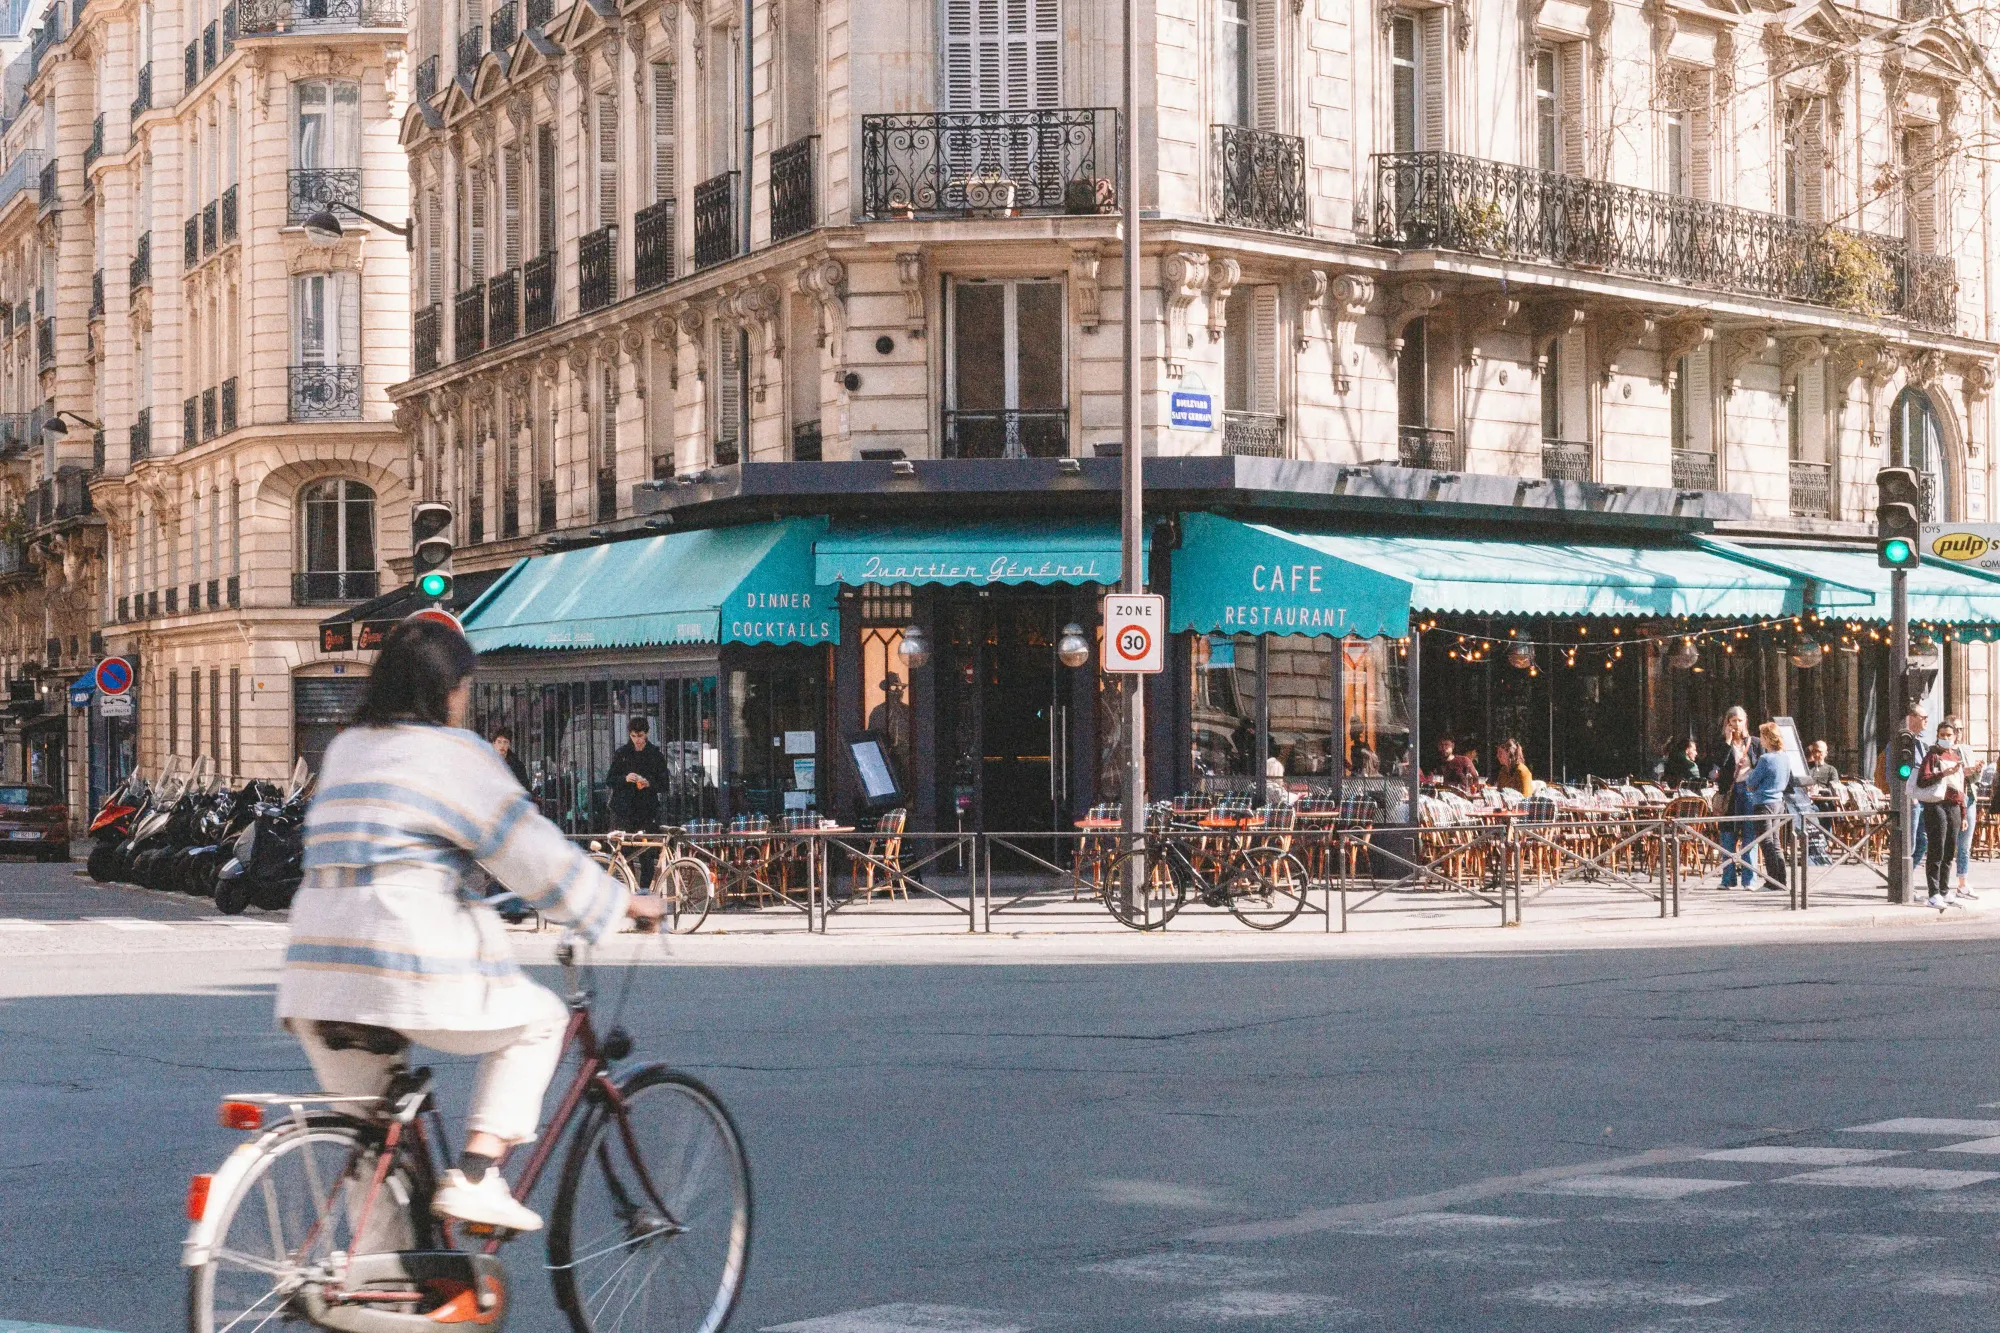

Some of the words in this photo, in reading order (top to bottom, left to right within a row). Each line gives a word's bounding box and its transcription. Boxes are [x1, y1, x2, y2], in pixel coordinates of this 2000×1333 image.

[1176, 399, 1208, 409] BOULEVARD
[1921, 525, 1941, 534] TOYS
[861, 556, 983, 578] Quartier
[986, 556, 1100, 582] Général
[1252, 564, 1323, 592] CAFE
[747, 592, 811, 609] DINNER
[1116, 605, 1152, 616] ZONE
[1225, 605, 1347, 627] RESTAURANT
[732, 621, 829, 638] COCKTAILS
[1123, 635, 1145, 650] 30
